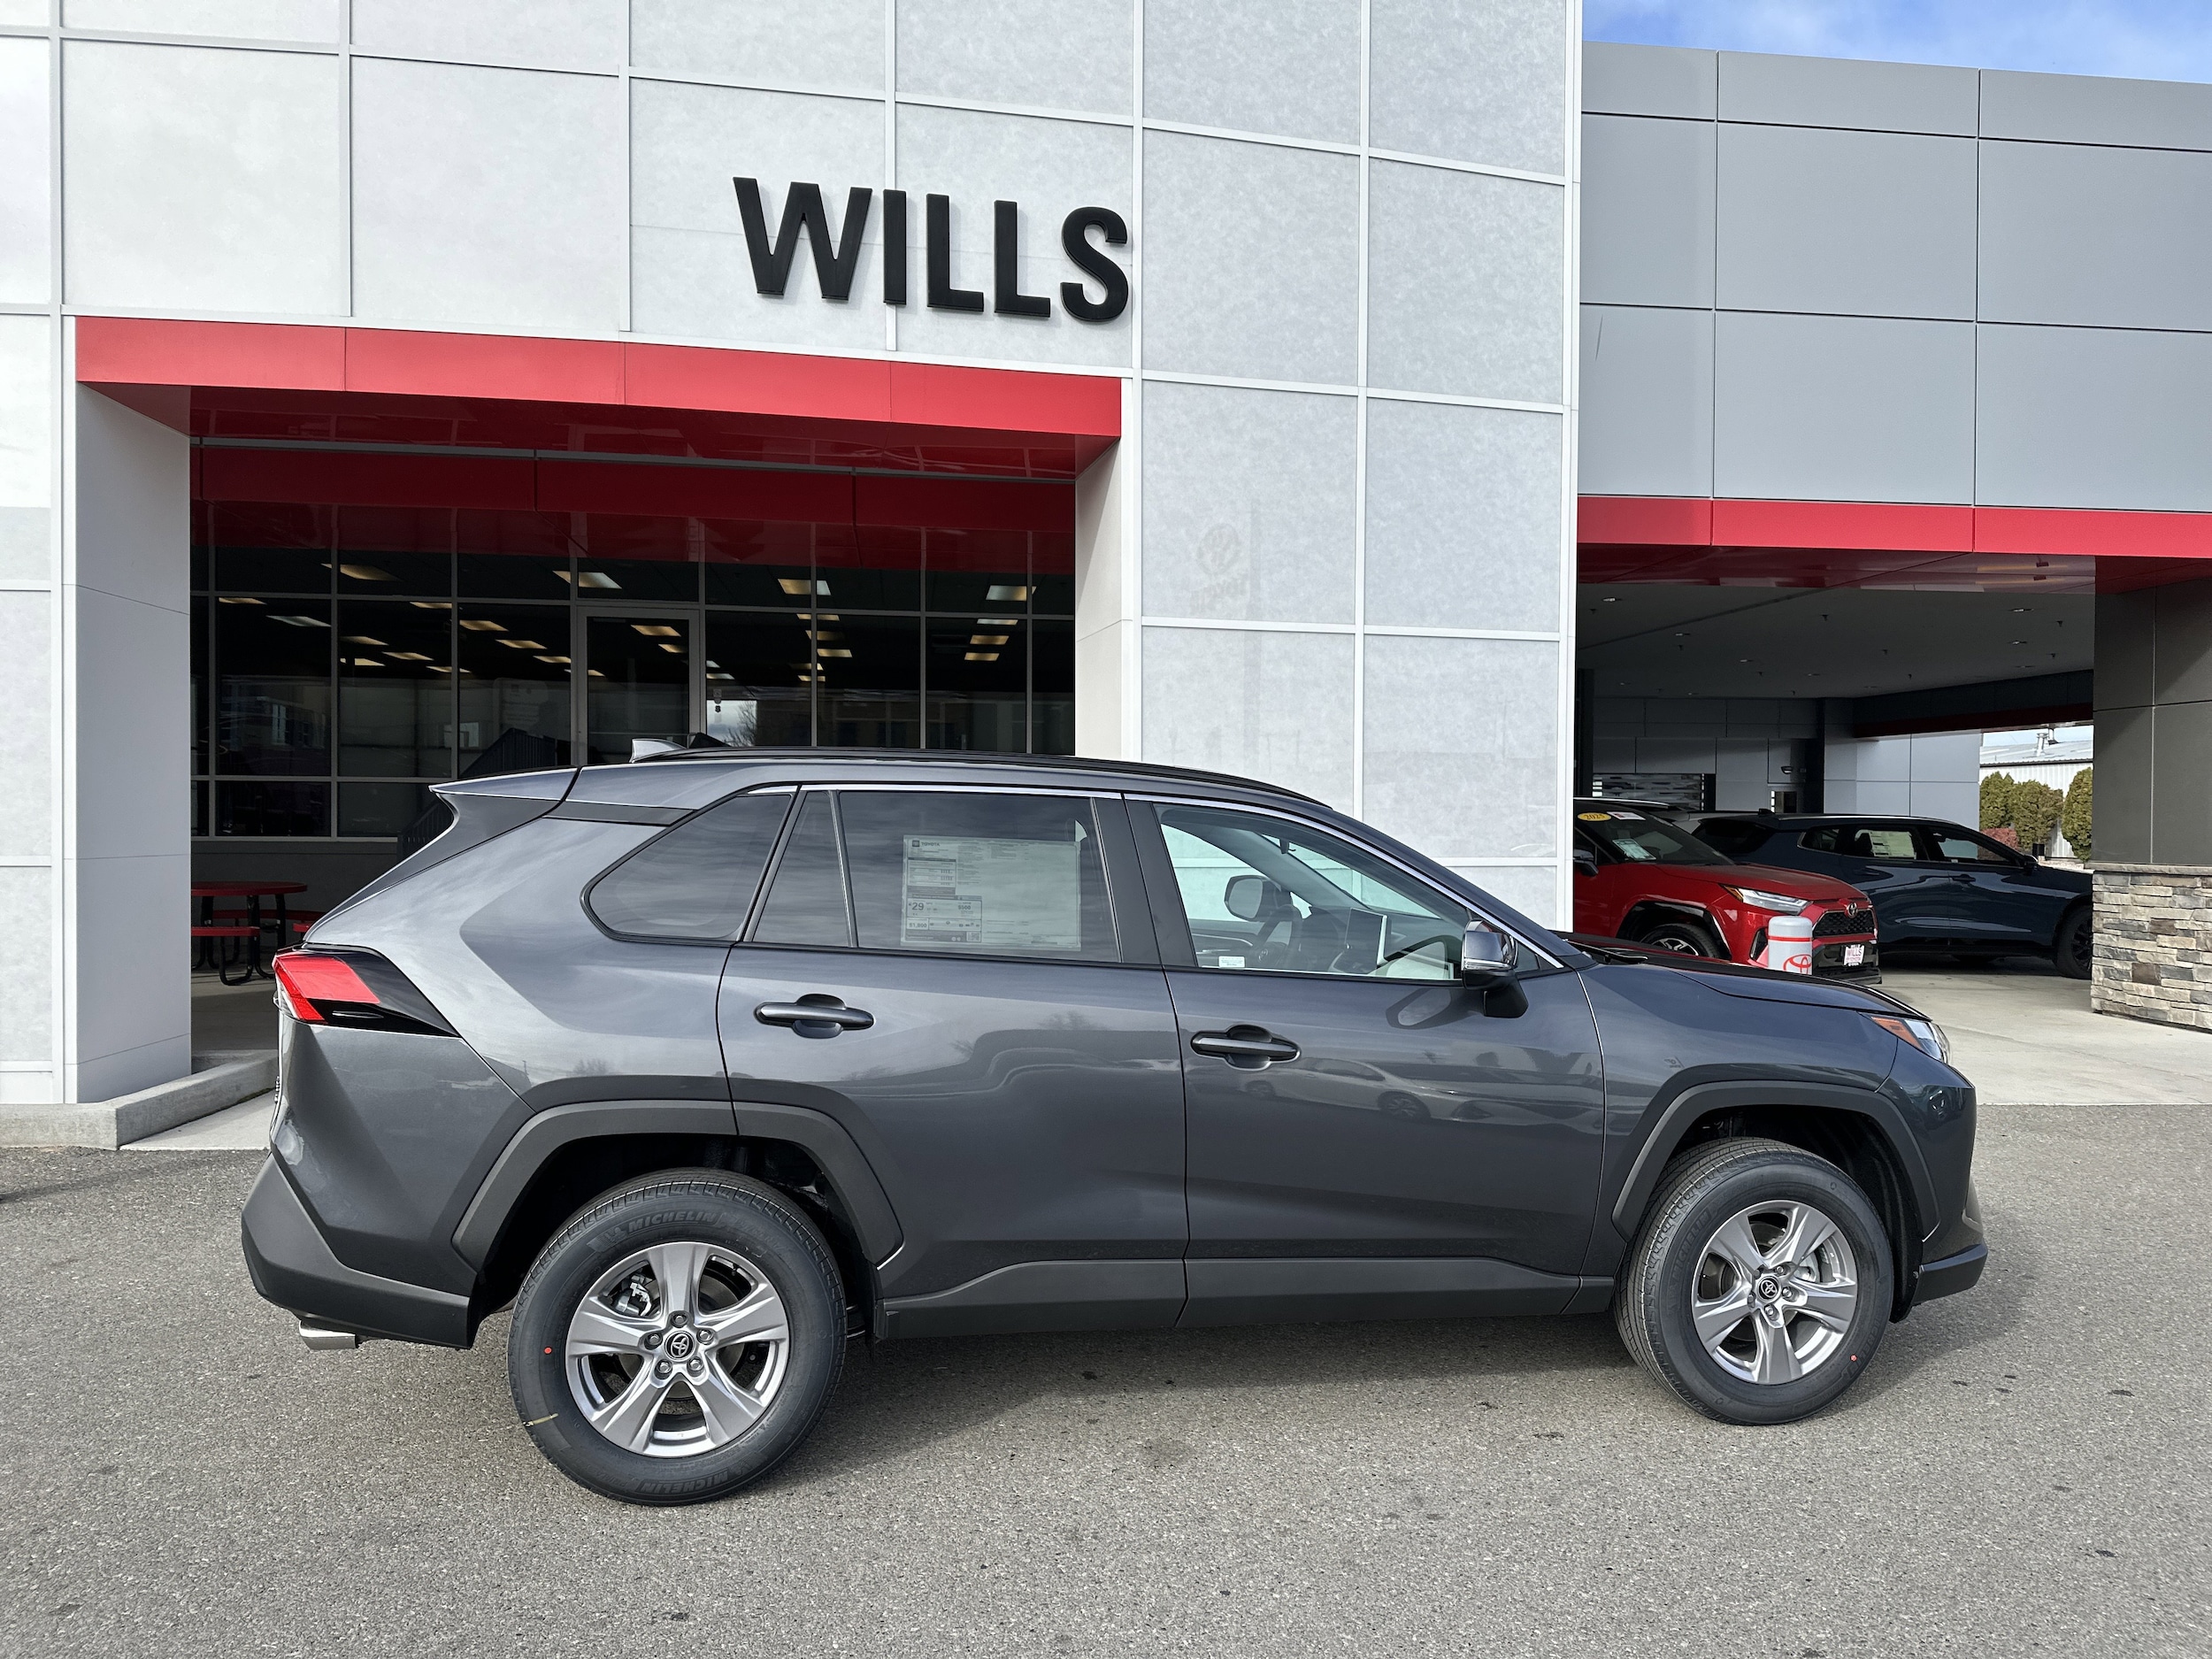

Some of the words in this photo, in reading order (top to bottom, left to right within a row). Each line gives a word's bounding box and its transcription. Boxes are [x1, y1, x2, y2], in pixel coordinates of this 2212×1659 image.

[733, 177, 1129, 322] WILLS
[911, 902, 925, 910] 29
[628, 1211, 717, 1233] MICHELIN
[1671, 1207, 1712, 1279] MICHELIN
[641, 1471, 728, 1494] MICHELIN
